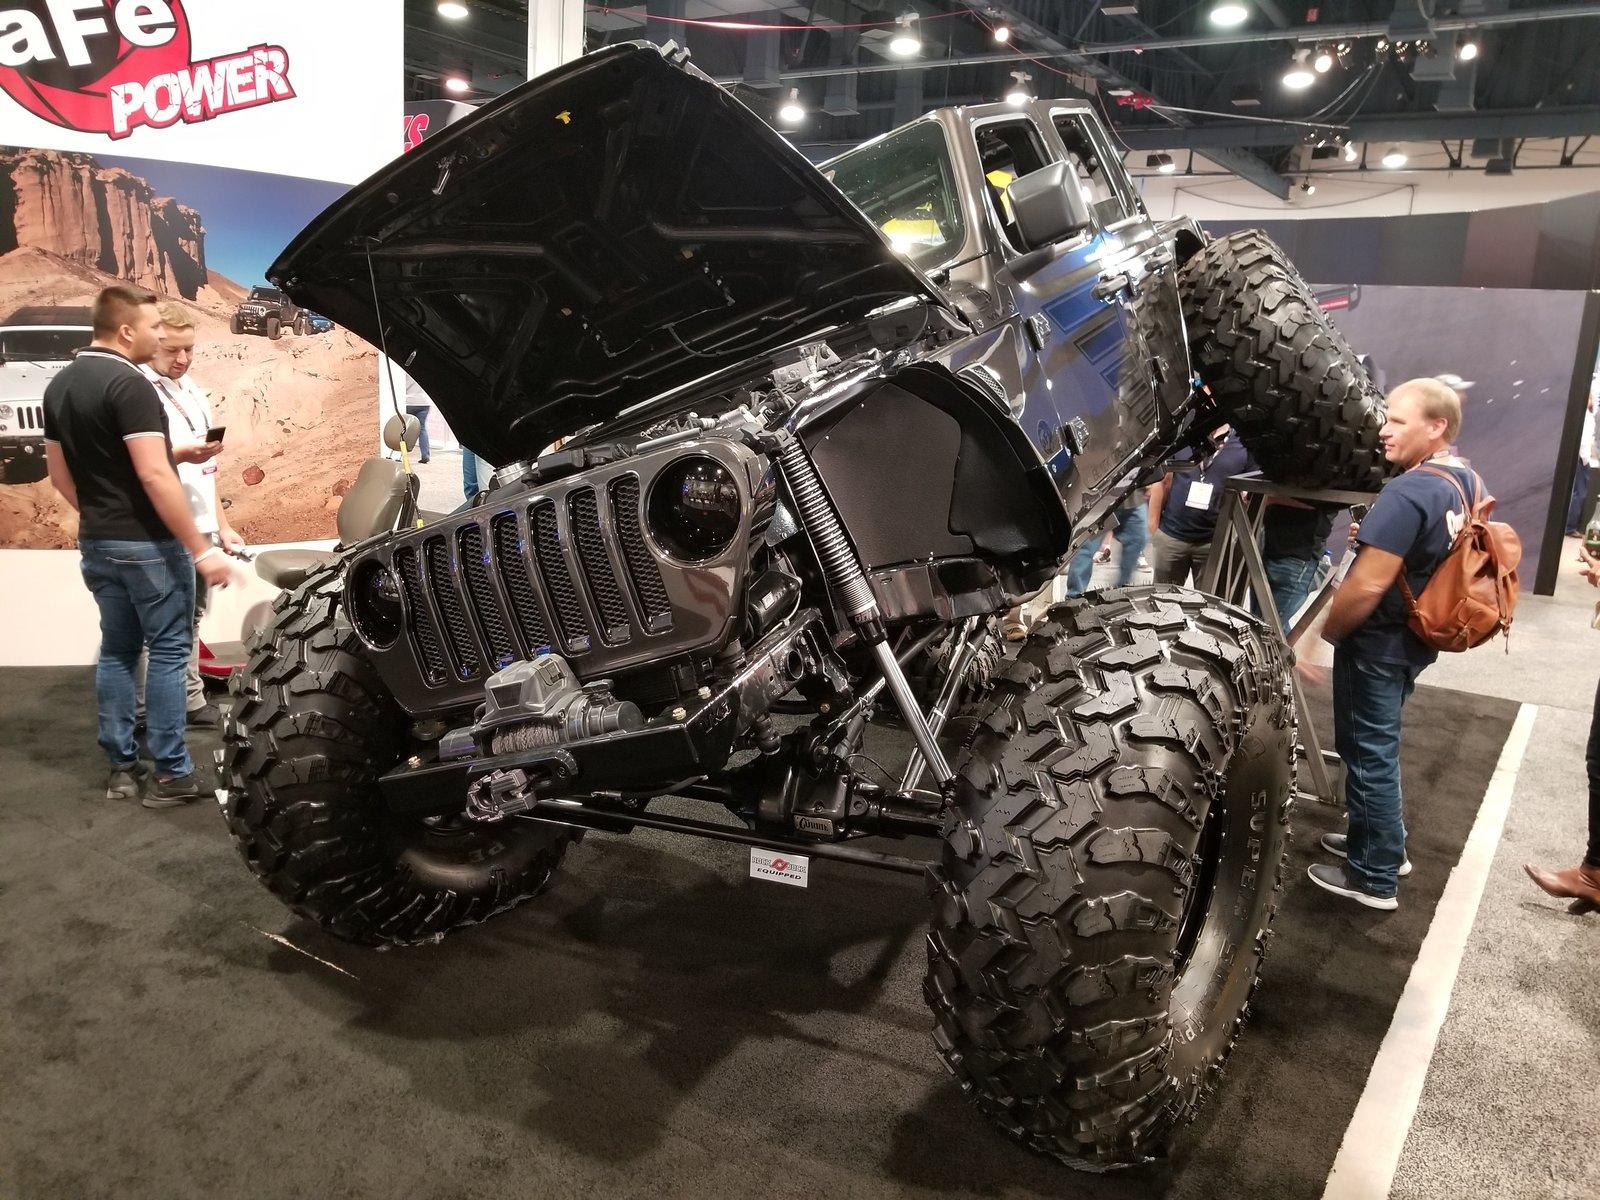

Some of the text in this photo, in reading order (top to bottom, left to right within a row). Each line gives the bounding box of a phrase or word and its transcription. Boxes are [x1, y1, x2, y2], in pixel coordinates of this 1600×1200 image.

[0, 0, 179, 67] aFe
[109, 46, 291, 135] POWER
[756, 867, 802, 880] EQUIPPED
